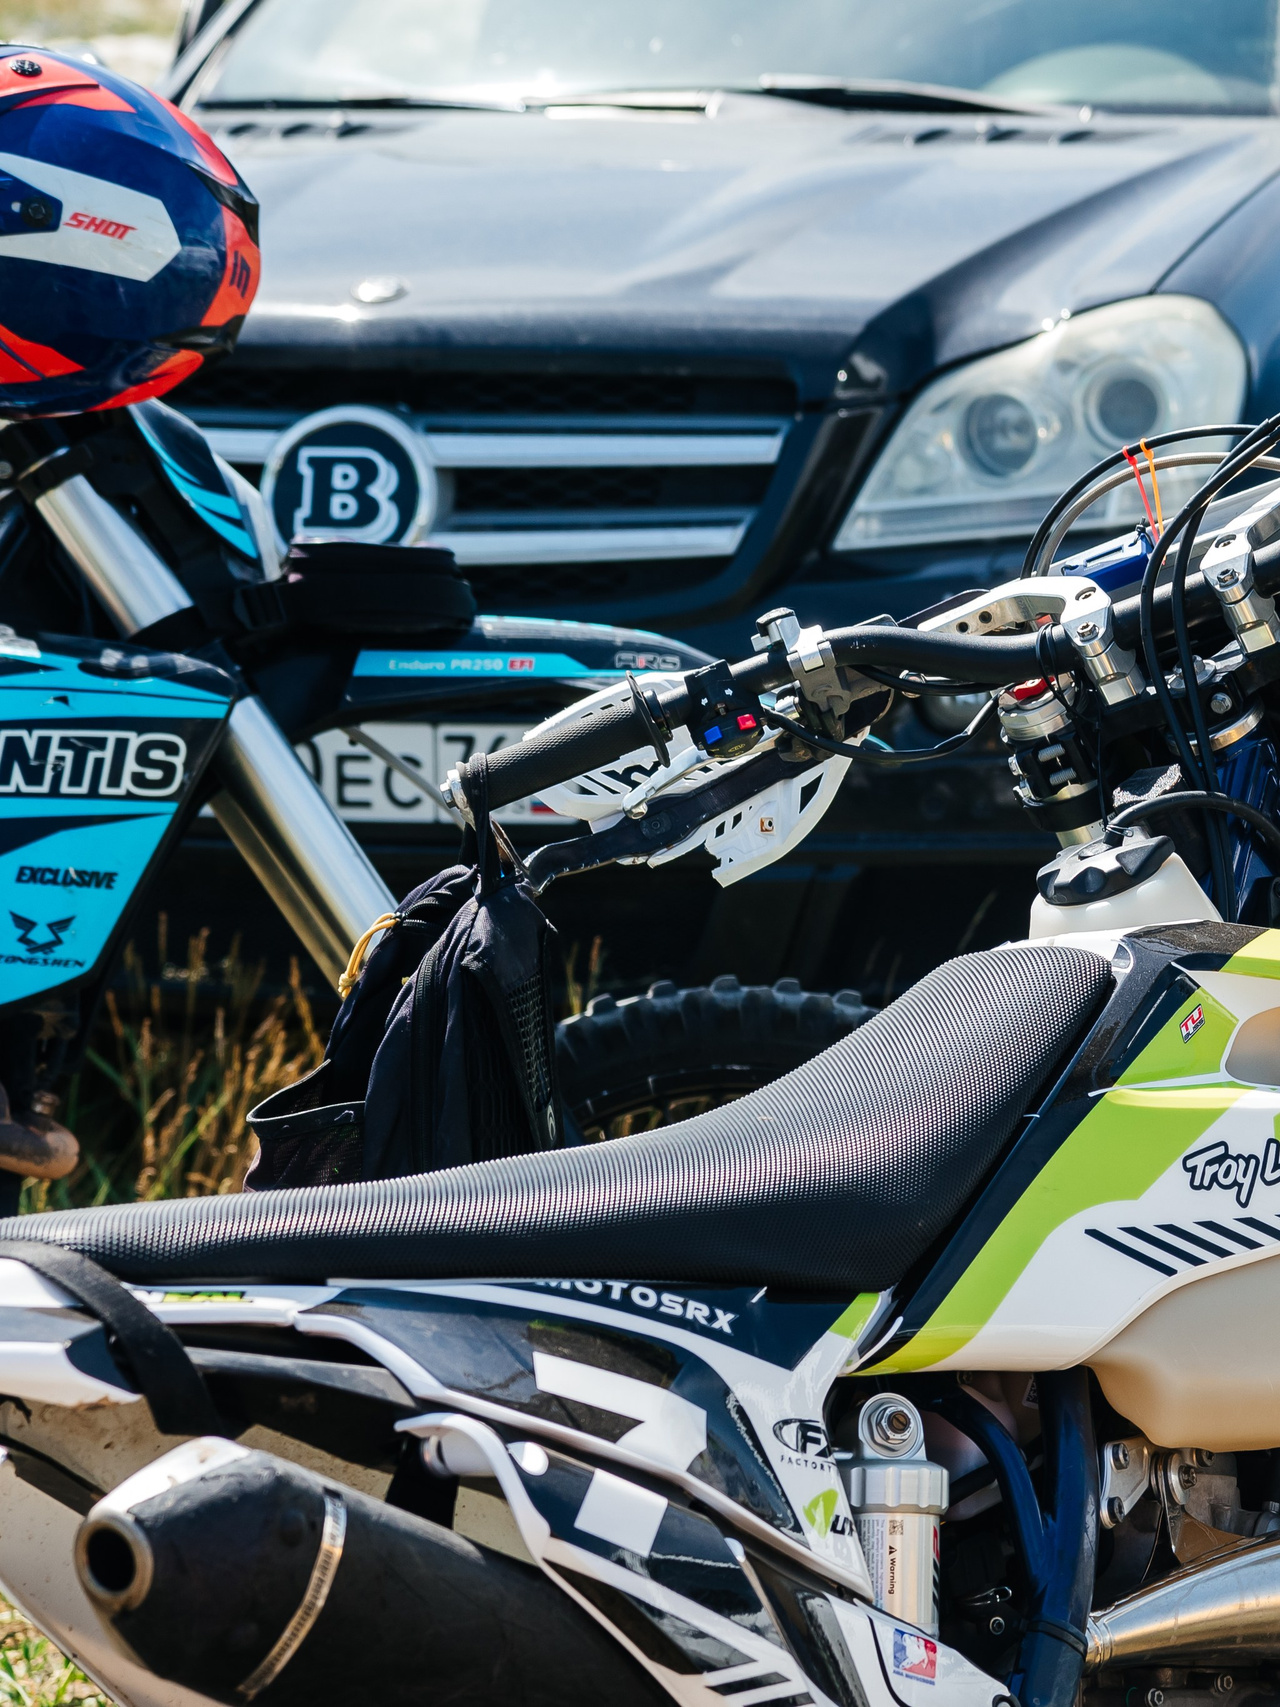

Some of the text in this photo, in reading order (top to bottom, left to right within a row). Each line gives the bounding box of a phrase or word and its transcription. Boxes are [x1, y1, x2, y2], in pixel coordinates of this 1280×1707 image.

[63, 212, 138, 240] SHOT
[293, 447, 399, 544] B
[388, 659, 447, 671] Enduro
[450, 658, 504, 671] PR250
[15, 866, 118, 890] EXCLUSIVE
[1183, 1141, 1258, 1207] Troy
[780, 1454, 832, 1473] FACTORY
[888, 1557, 897, 1595] Warning
